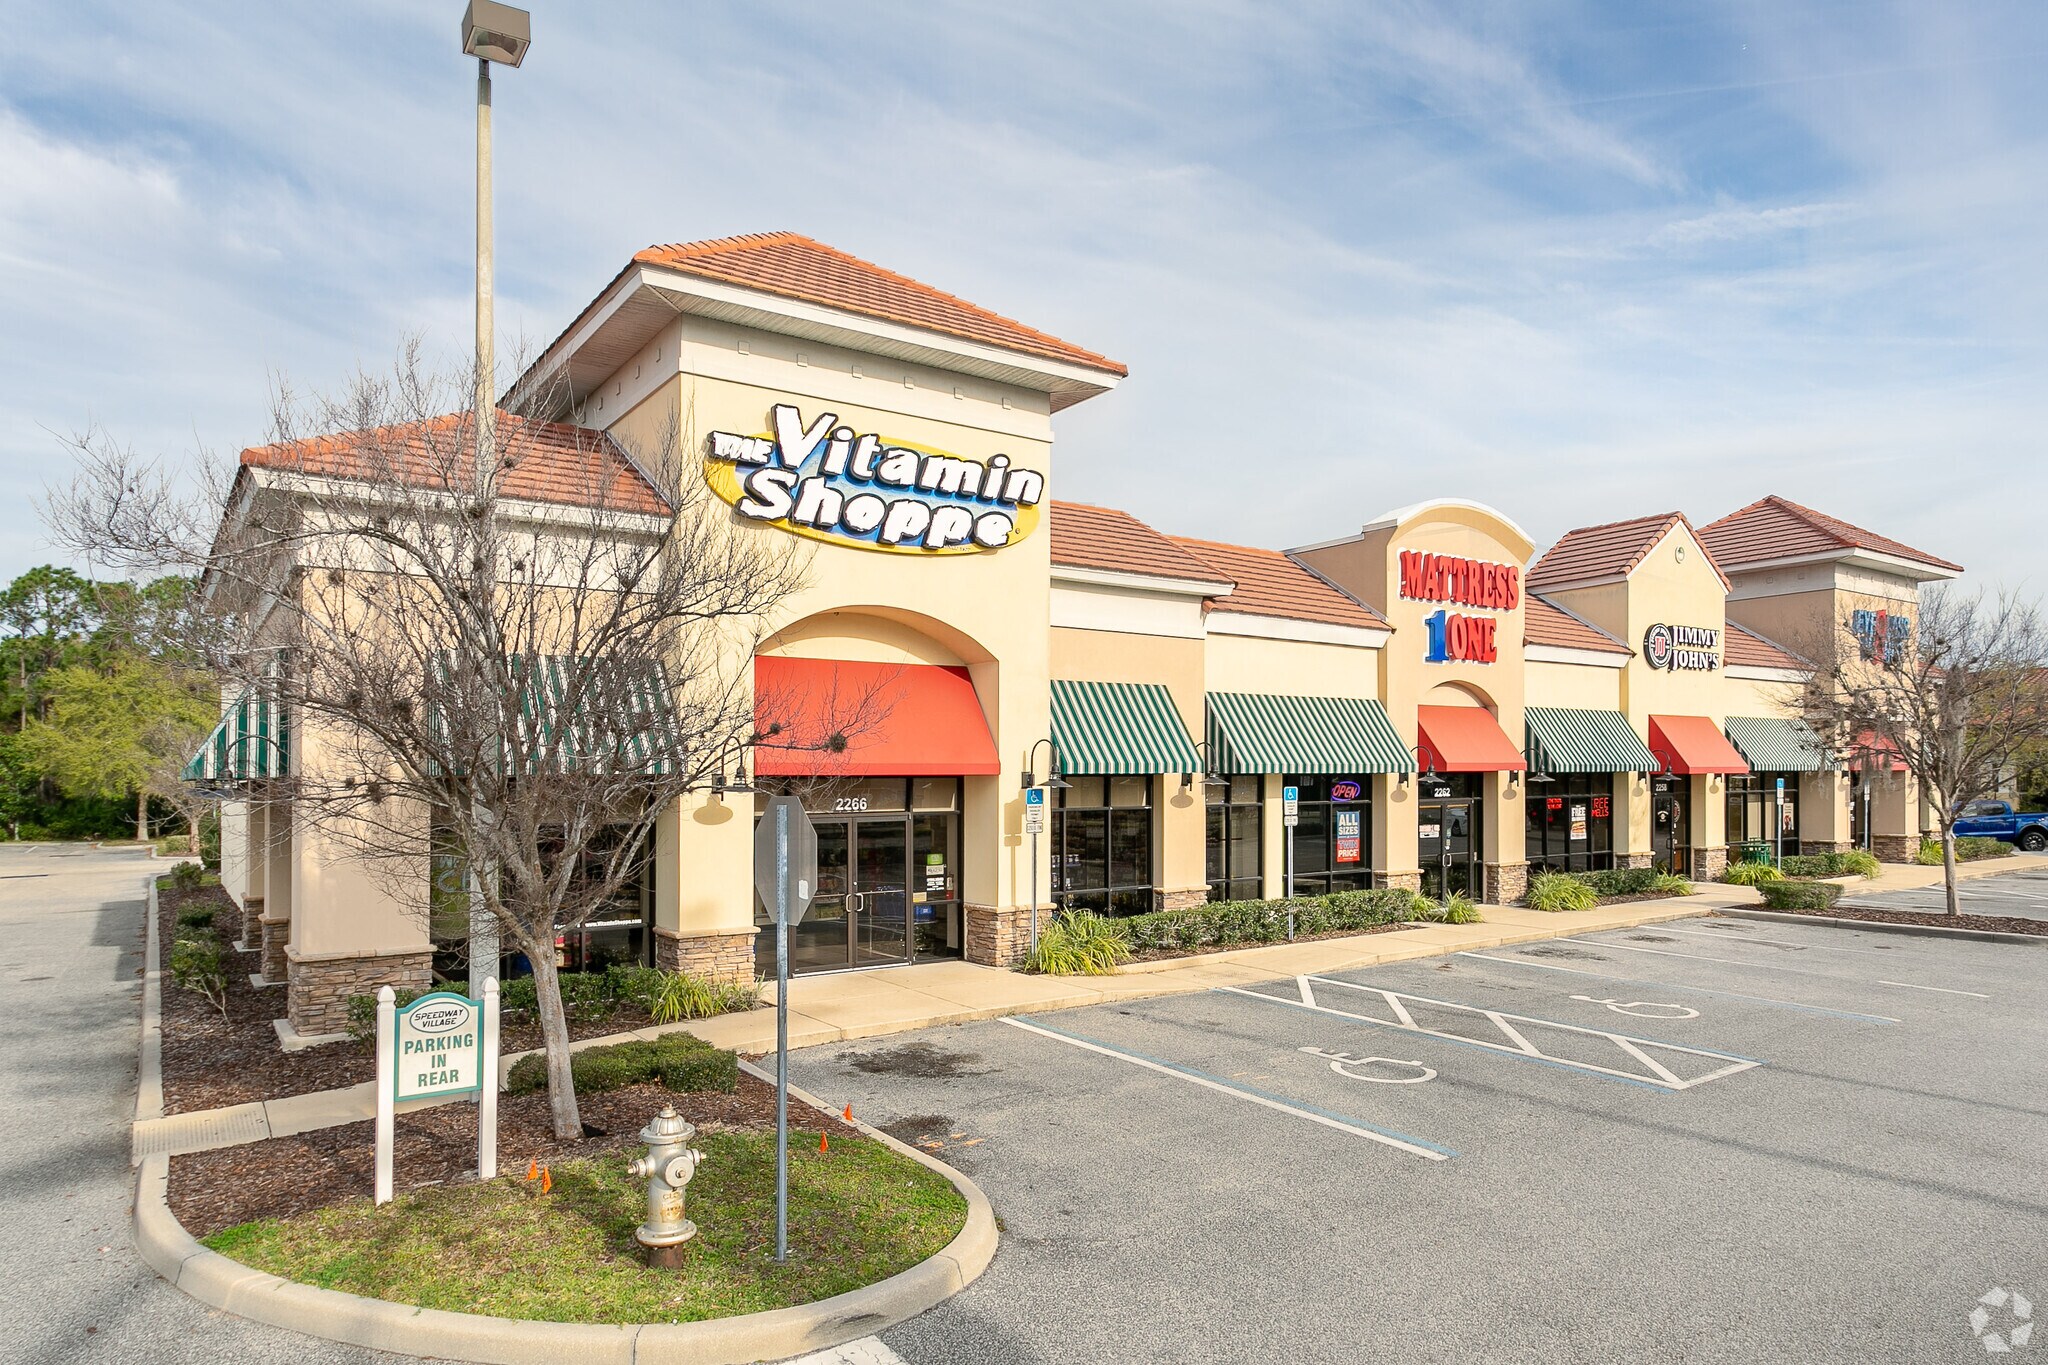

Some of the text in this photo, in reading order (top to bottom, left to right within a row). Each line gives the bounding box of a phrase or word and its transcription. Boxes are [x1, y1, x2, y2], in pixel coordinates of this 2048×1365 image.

[771, 403, 1045, 505] Vitamin
[734, 467, 1014, 550] Shoppe
[1400, 550, 1519, 610] MATTRESS
[1425, 610, 1497, 663] 1 ONE
[1671, 625, 1720, 647] JIMMY
[1671, 649, 1720, 671] JOHN'S
[1332, 784, 1357, 799] OPEN
[1434, 787, 1451, 798] 2262
[835, 797, 868, 811] 2266
[1338, 813, 1358, 827] ALL
[1338, 826, 1359, 836] SIZES
[1338, 840, 1358, 850] TWIN
[1338, 849, 1359, 858] PRICE
[414, 1009, 464, 1021] SPEEDWAY
[422, 1017, 458, 1028] VILLAGE
[404, 1033, 473, 1054] PARKING
[431, 1054, 447, 1068] IN
[418, 1069, 459, 1087] REAR
